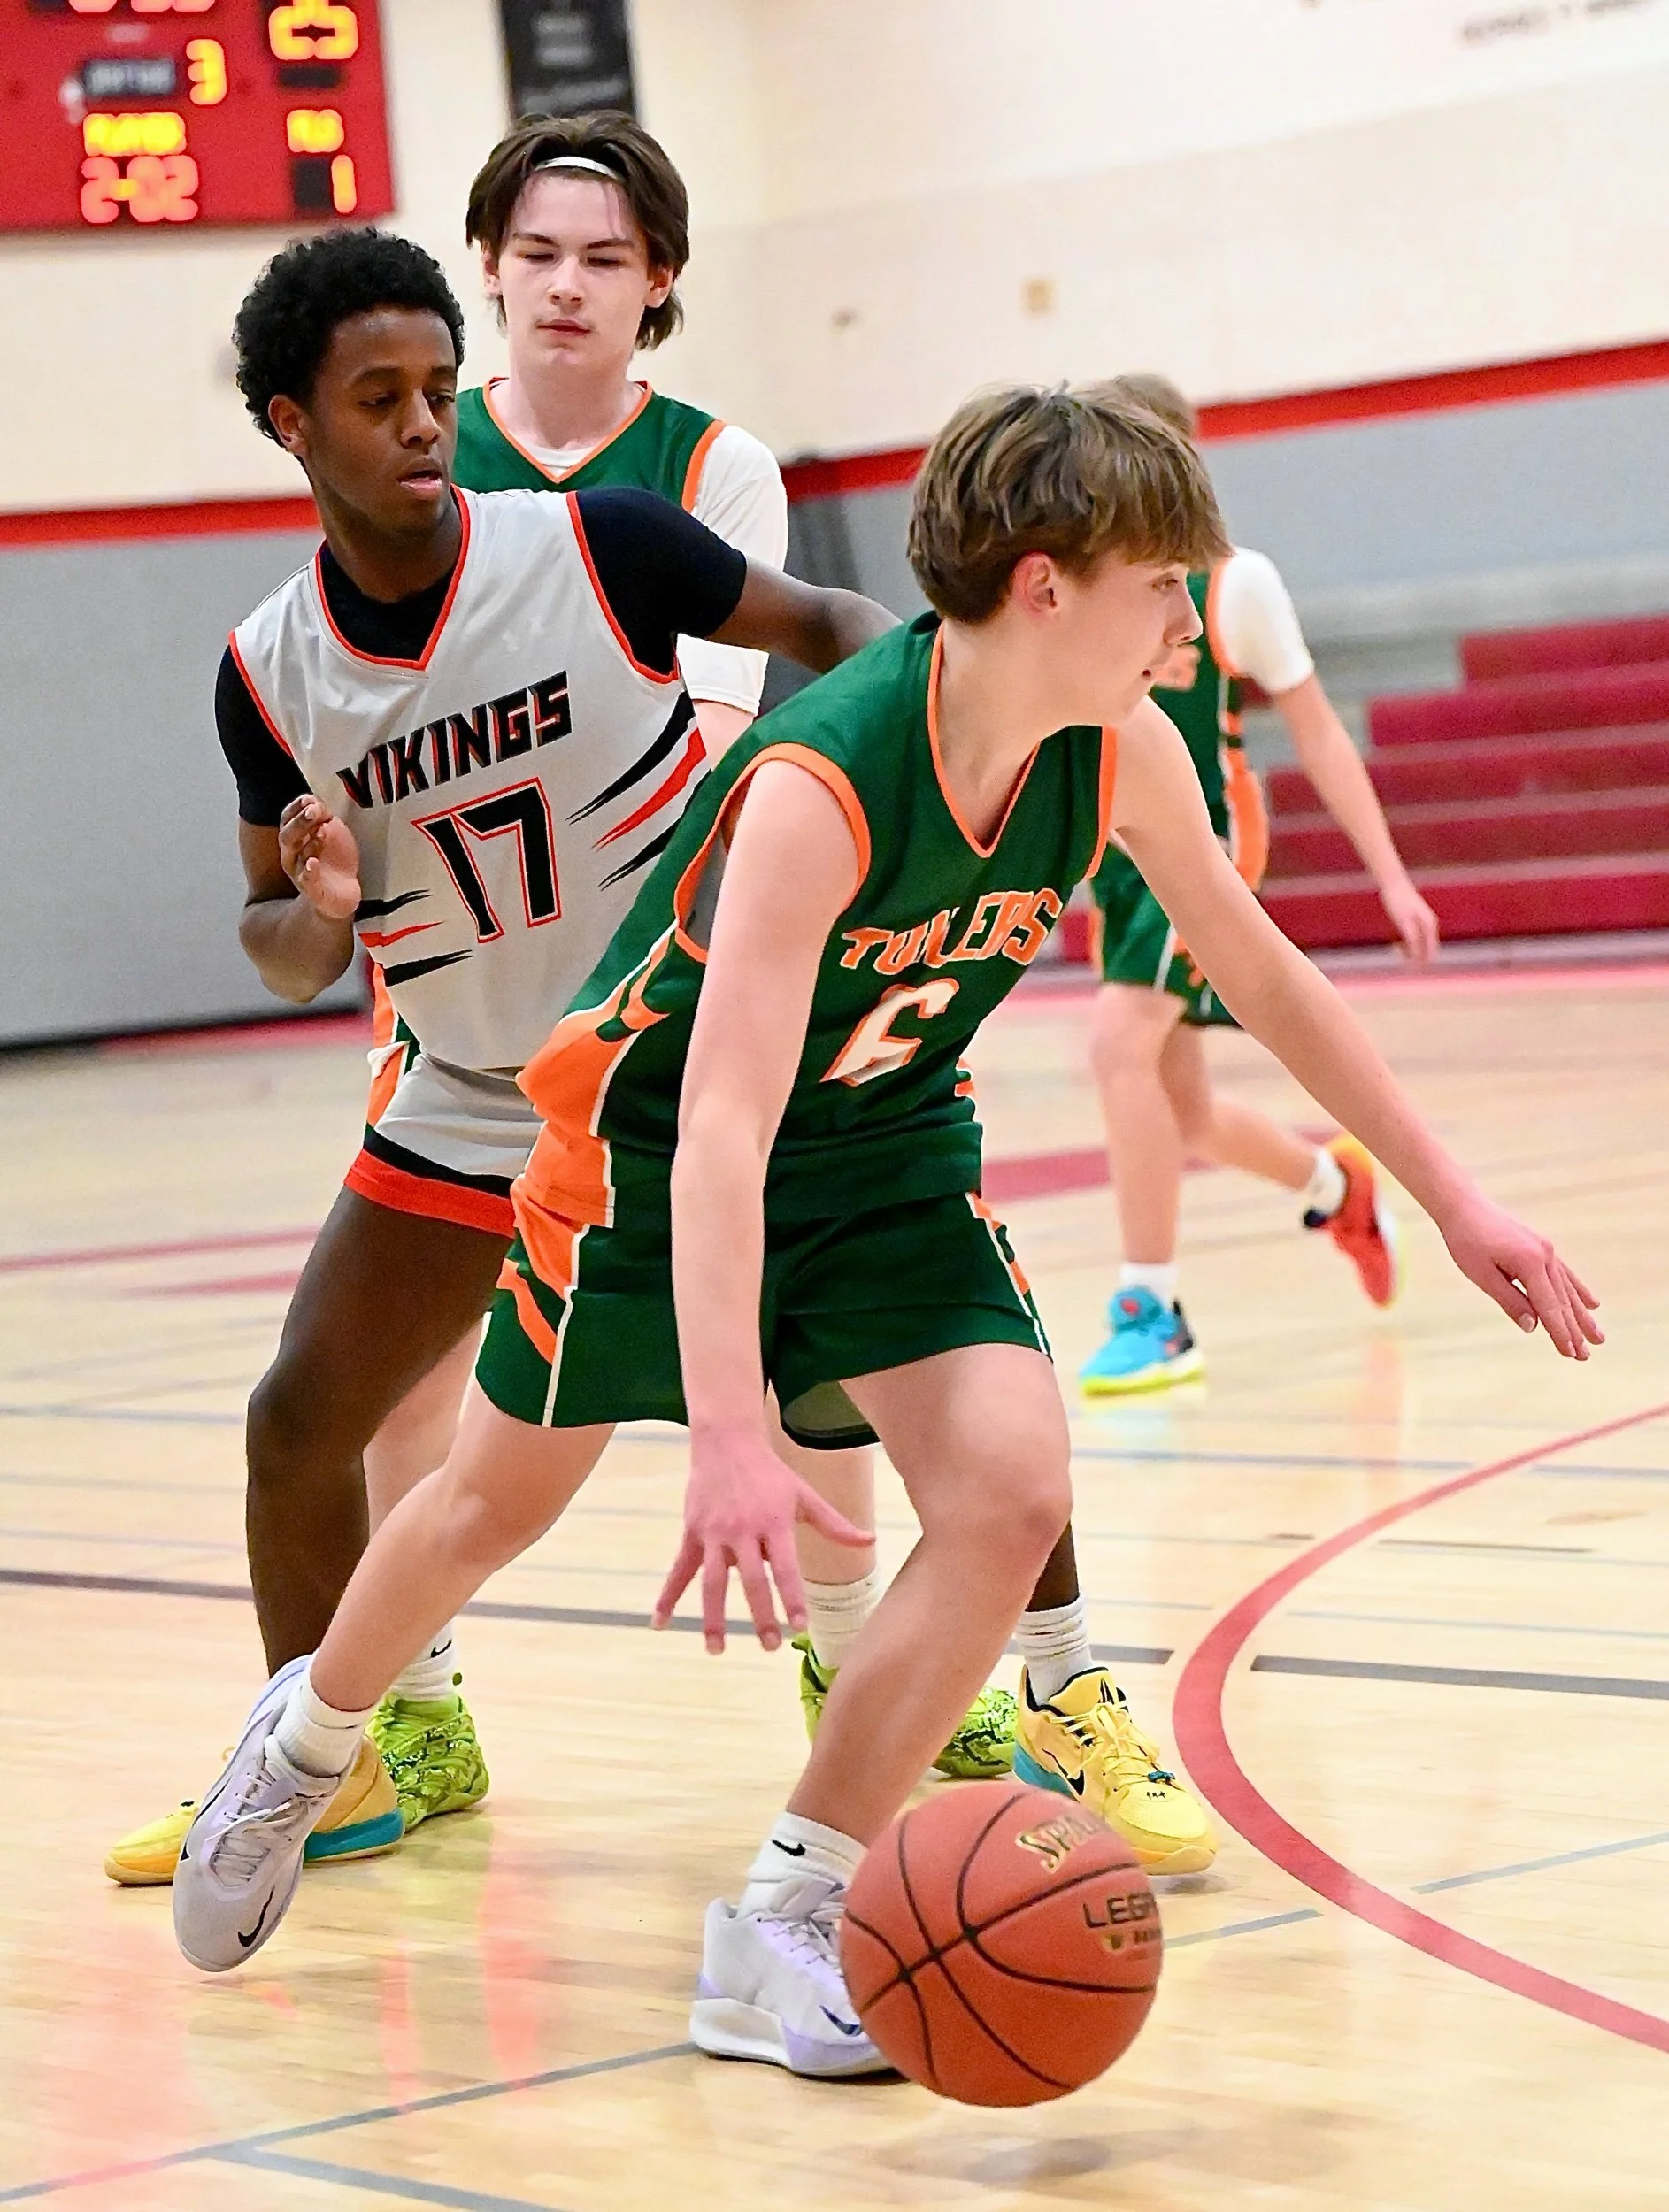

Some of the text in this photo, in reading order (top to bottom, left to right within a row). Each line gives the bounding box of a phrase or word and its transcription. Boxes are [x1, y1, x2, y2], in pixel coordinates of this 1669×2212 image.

[186, 39, 227, 104] 3
[336, 670, 572, 808] VIKINGS
[411, 777, 561, 943] 17
